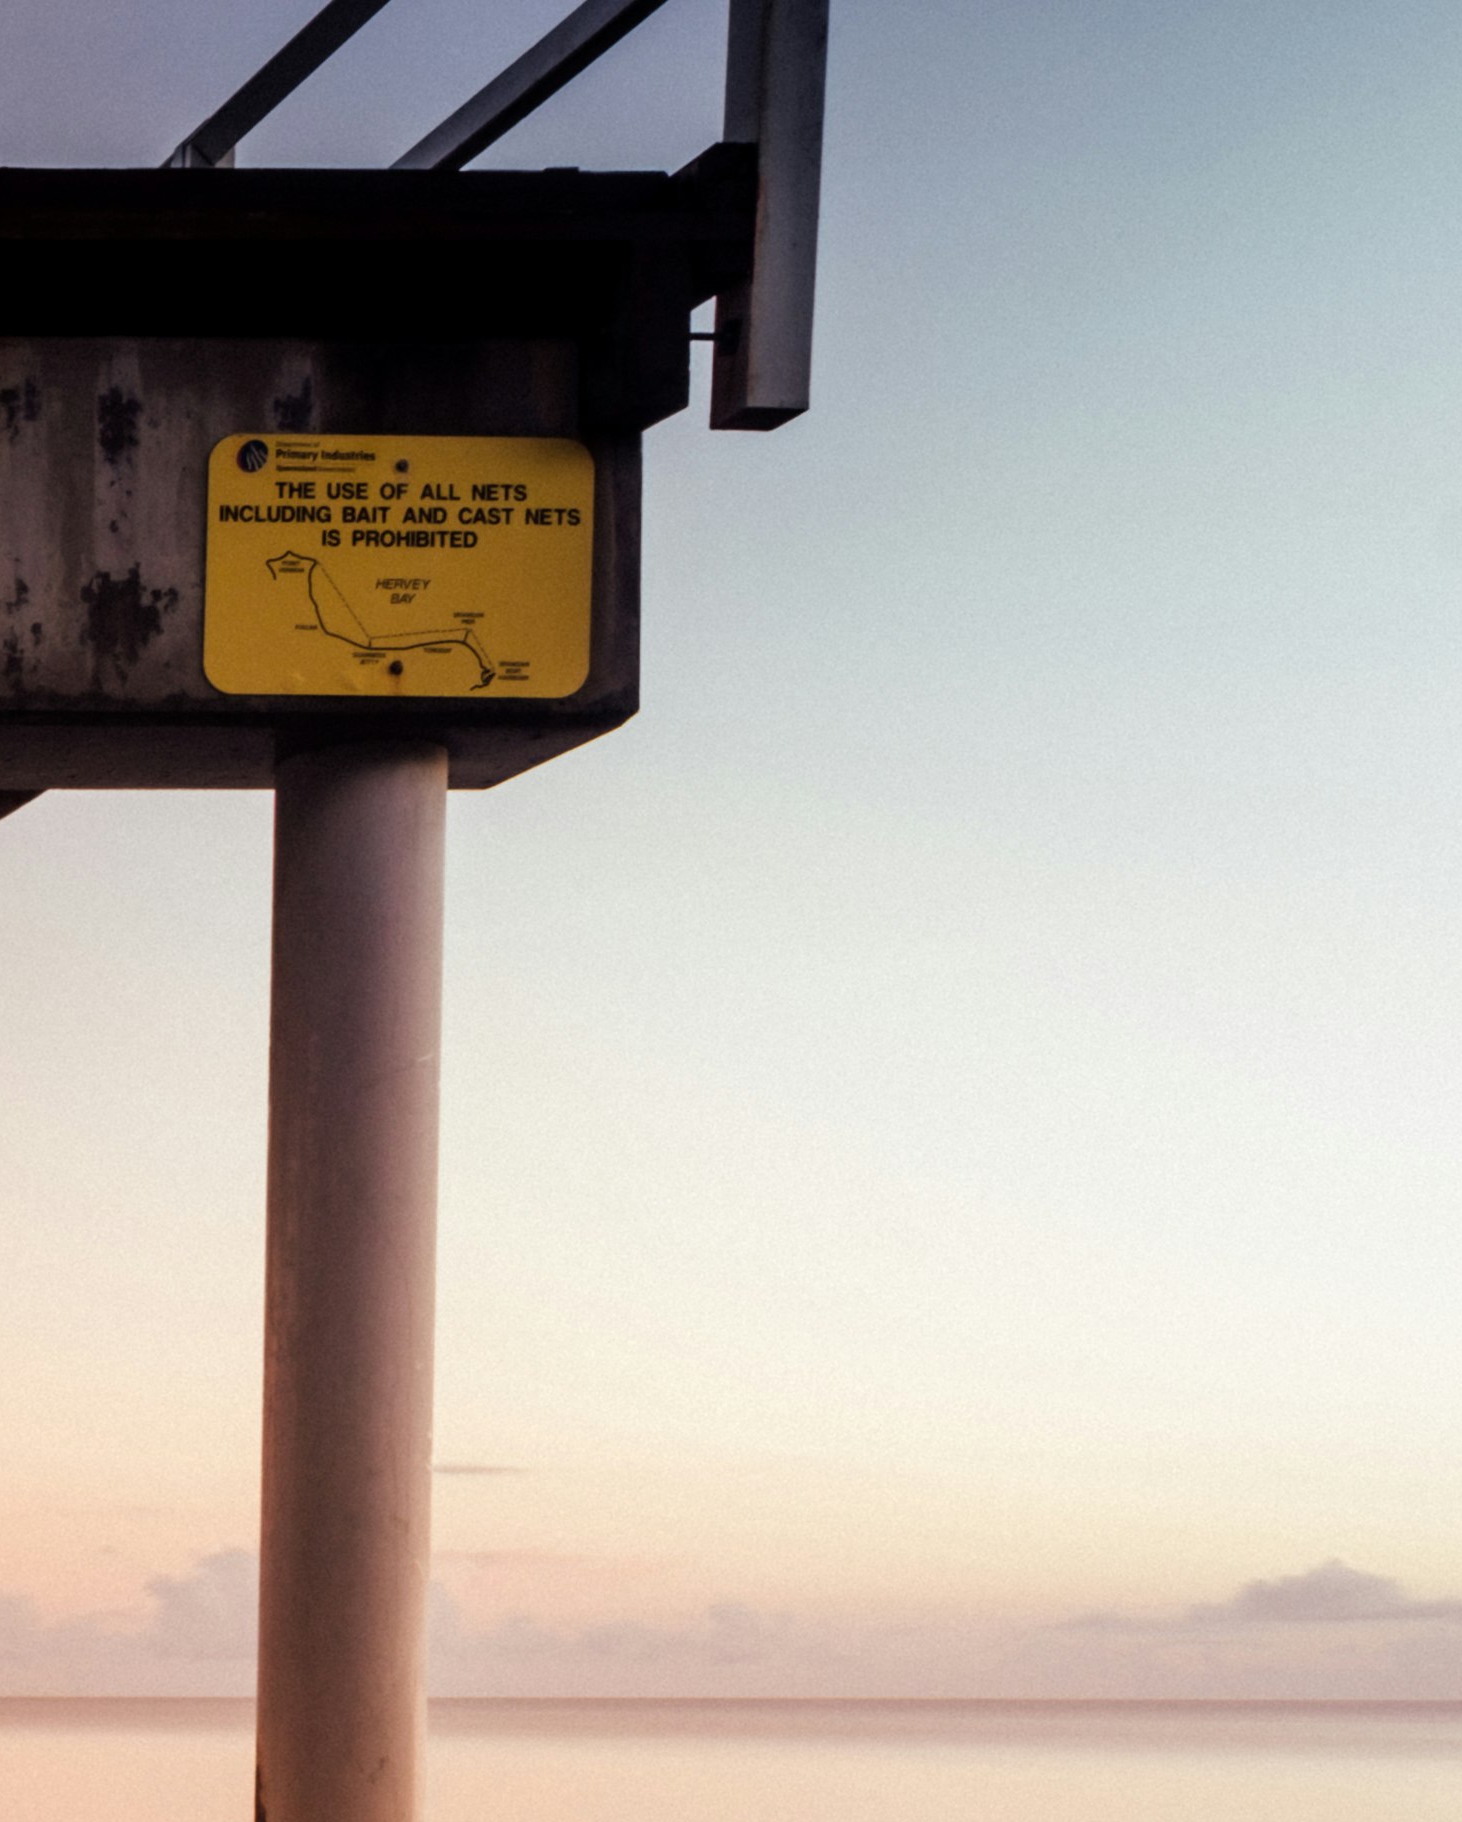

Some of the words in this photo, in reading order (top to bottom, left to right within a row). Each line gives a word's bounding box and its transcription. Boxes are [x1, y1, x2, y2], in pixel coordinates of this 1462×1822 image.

[275, 482, 315, 499] THE
[327, 483, 368, 500] USE
[380, 483, 408, 500] OF
[421, 484, 460, 501] ALL
[472, 484, 527, 501] NETS
[220, 505, 331, 523] INCLUDING
[342, 506, 390, 523] BAIT
[403, 507, 447, 524] AND
[458, 507, 514, 525] CAST
[525, 508, 580, 526] NETS
[322, 529, 340, 547] IS
[352, 530, 478, 548] PROHIBITED
[376, 579, 430, 590] HERVEY
[391, 593, 415, 604] BAY
